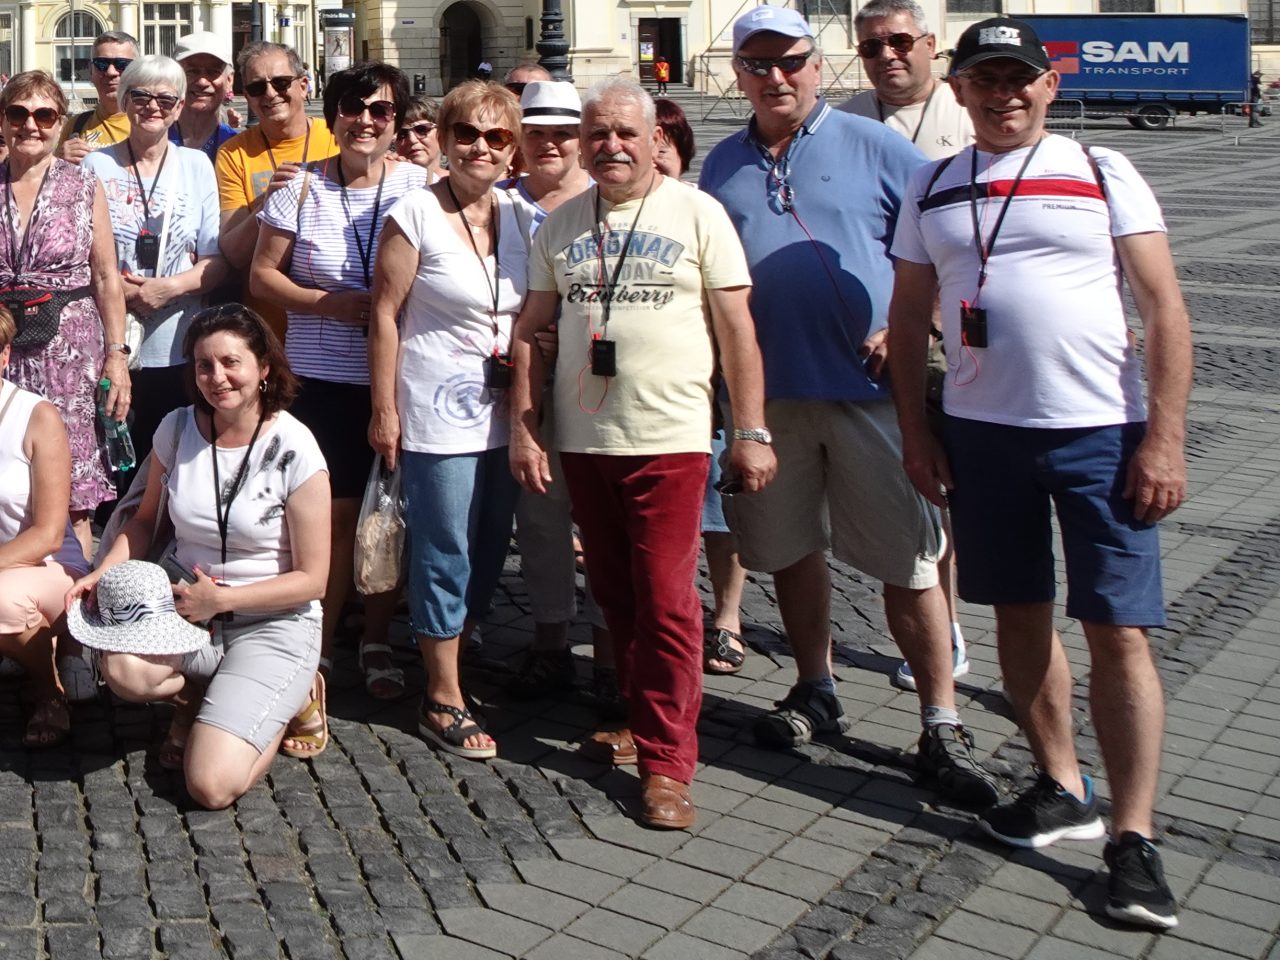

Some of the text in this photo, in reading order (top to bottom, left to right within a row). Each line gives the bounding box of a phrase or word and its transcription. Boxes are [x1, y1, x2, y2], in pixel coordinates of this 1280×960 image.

[1081, 41, 1190, 64] SAM
[1083, 66, 1190, 76] TRANSPORT
[570, 231, 674, 264] ORGNAL
